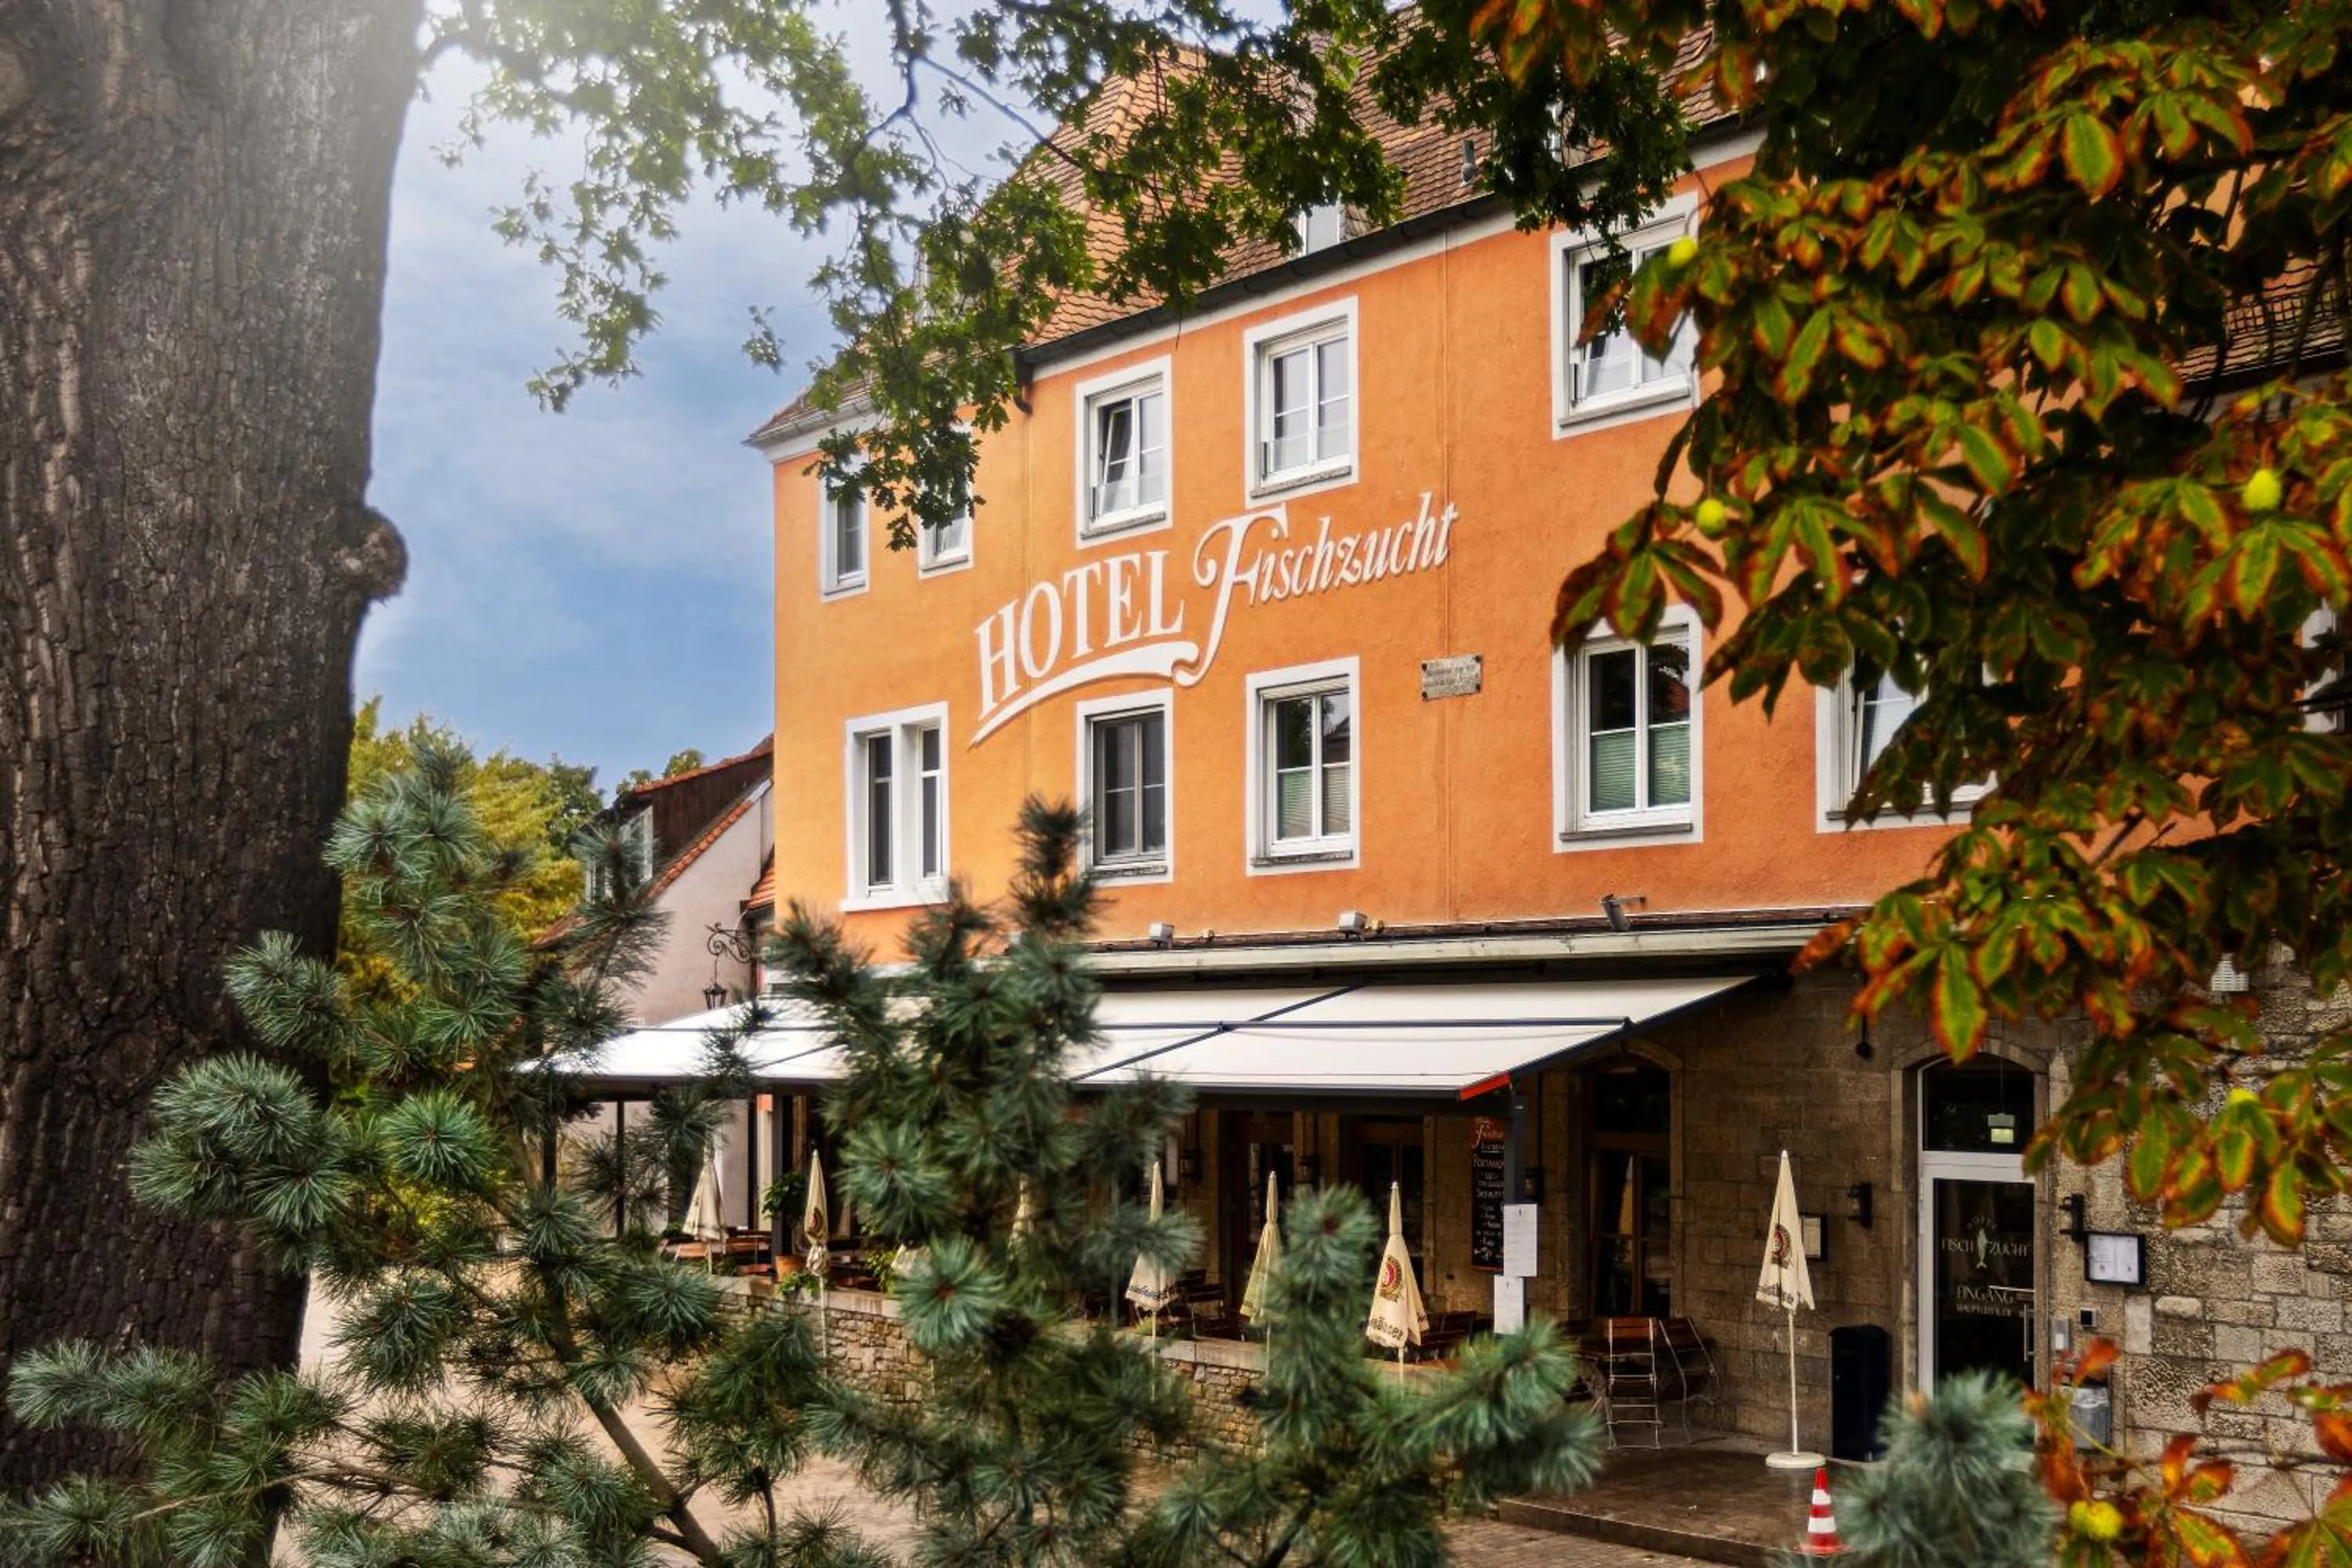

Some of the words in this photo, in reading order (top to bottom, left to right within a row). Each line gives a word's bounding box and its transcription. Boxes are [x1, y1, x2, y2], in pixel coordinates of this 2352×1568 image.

[974, 550, 1185, 720] HOTEL
[1188, 492, 1460, 685] Fischzucht
[1987, 1241, 2031, 1257] ZUCHT
[1957, 1284, 2013, 1305] EINGANG
